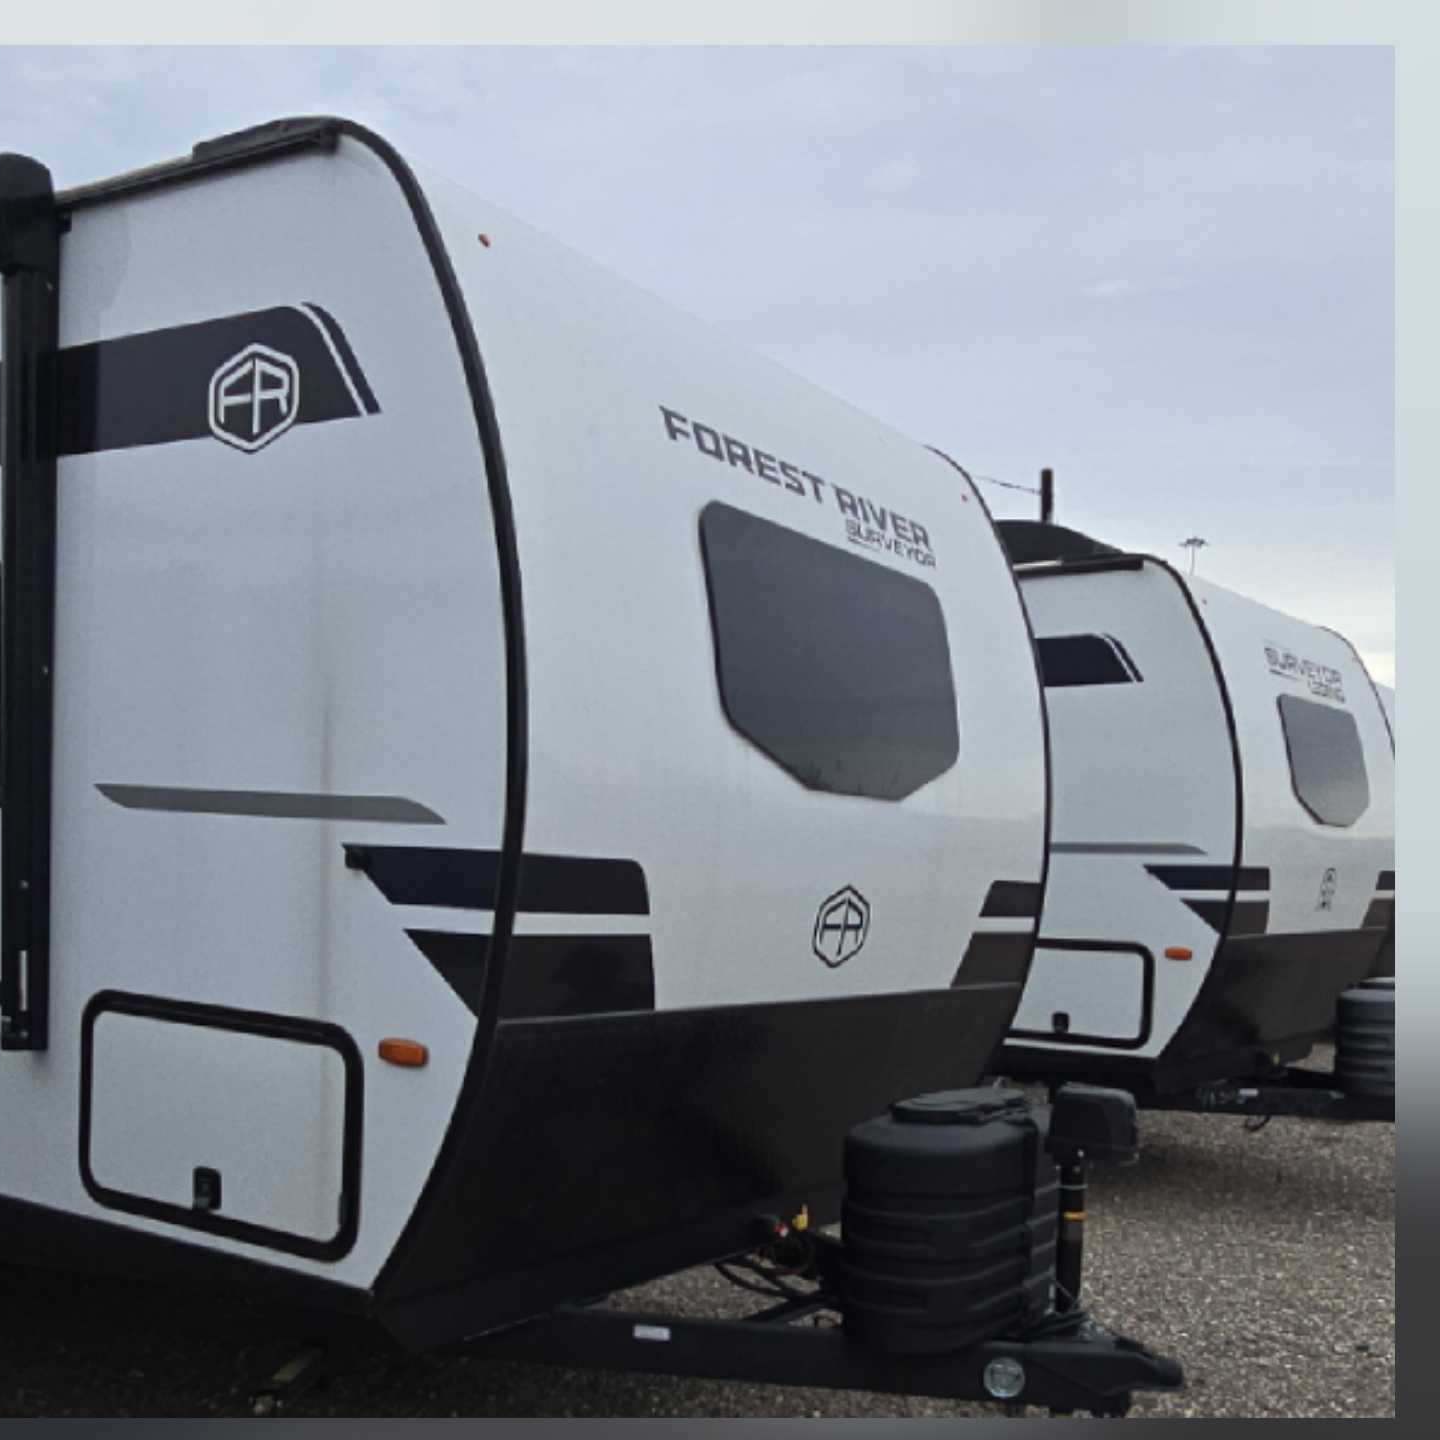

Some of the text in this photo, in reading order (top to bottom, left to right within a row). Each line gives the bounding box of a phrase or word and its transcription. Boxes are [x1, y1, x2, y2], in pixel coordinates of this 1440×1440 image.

[659, 404, 932, 549] FOREST RIVER
[846, 517, 937, 569] SURVEYOR
